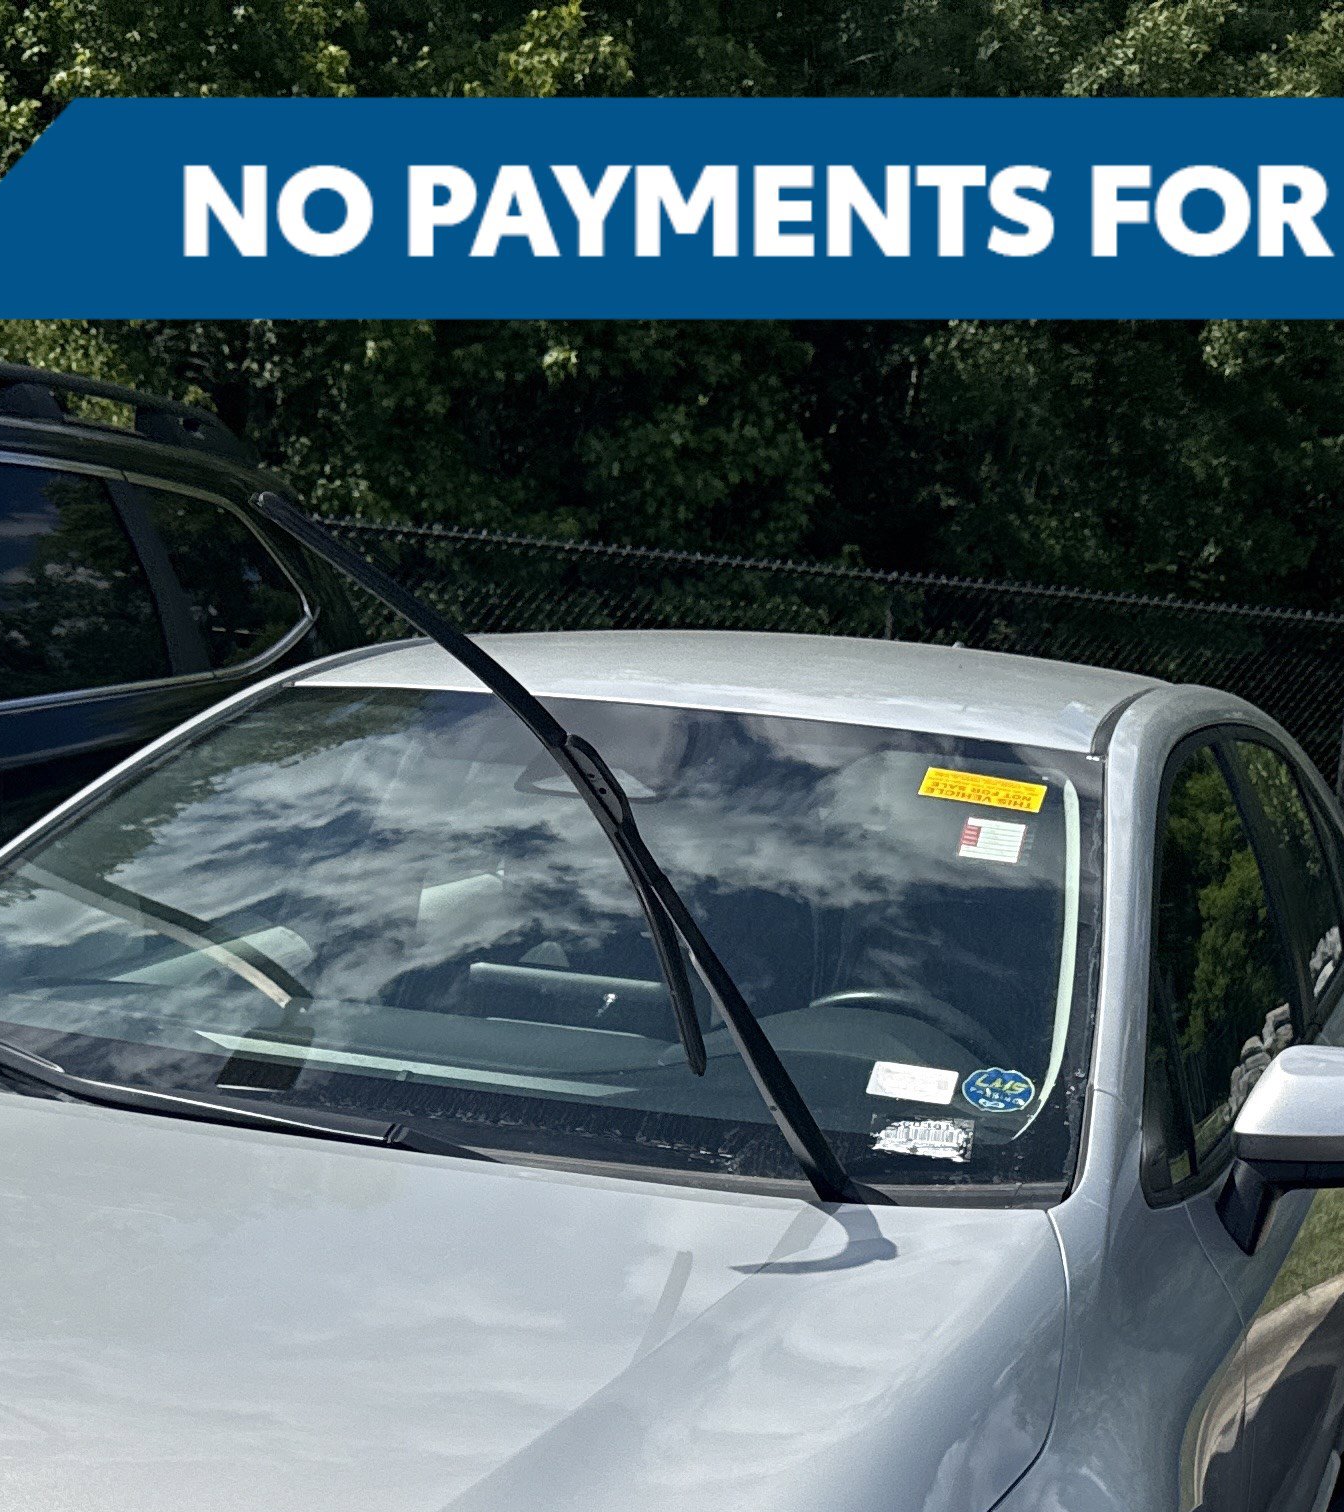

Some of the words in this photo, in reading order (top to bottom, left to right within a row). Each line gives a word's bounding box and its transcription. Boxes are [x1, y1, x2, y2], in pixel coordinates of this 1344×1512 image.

[932, 781, 967, 791] SALE
[925, 787, 992, 803] VEHICLE
[970, 787, 999, 797] FOR
[1004, 793, 1032, 802] NOT
[997, 798, 1031, 809] THIS
